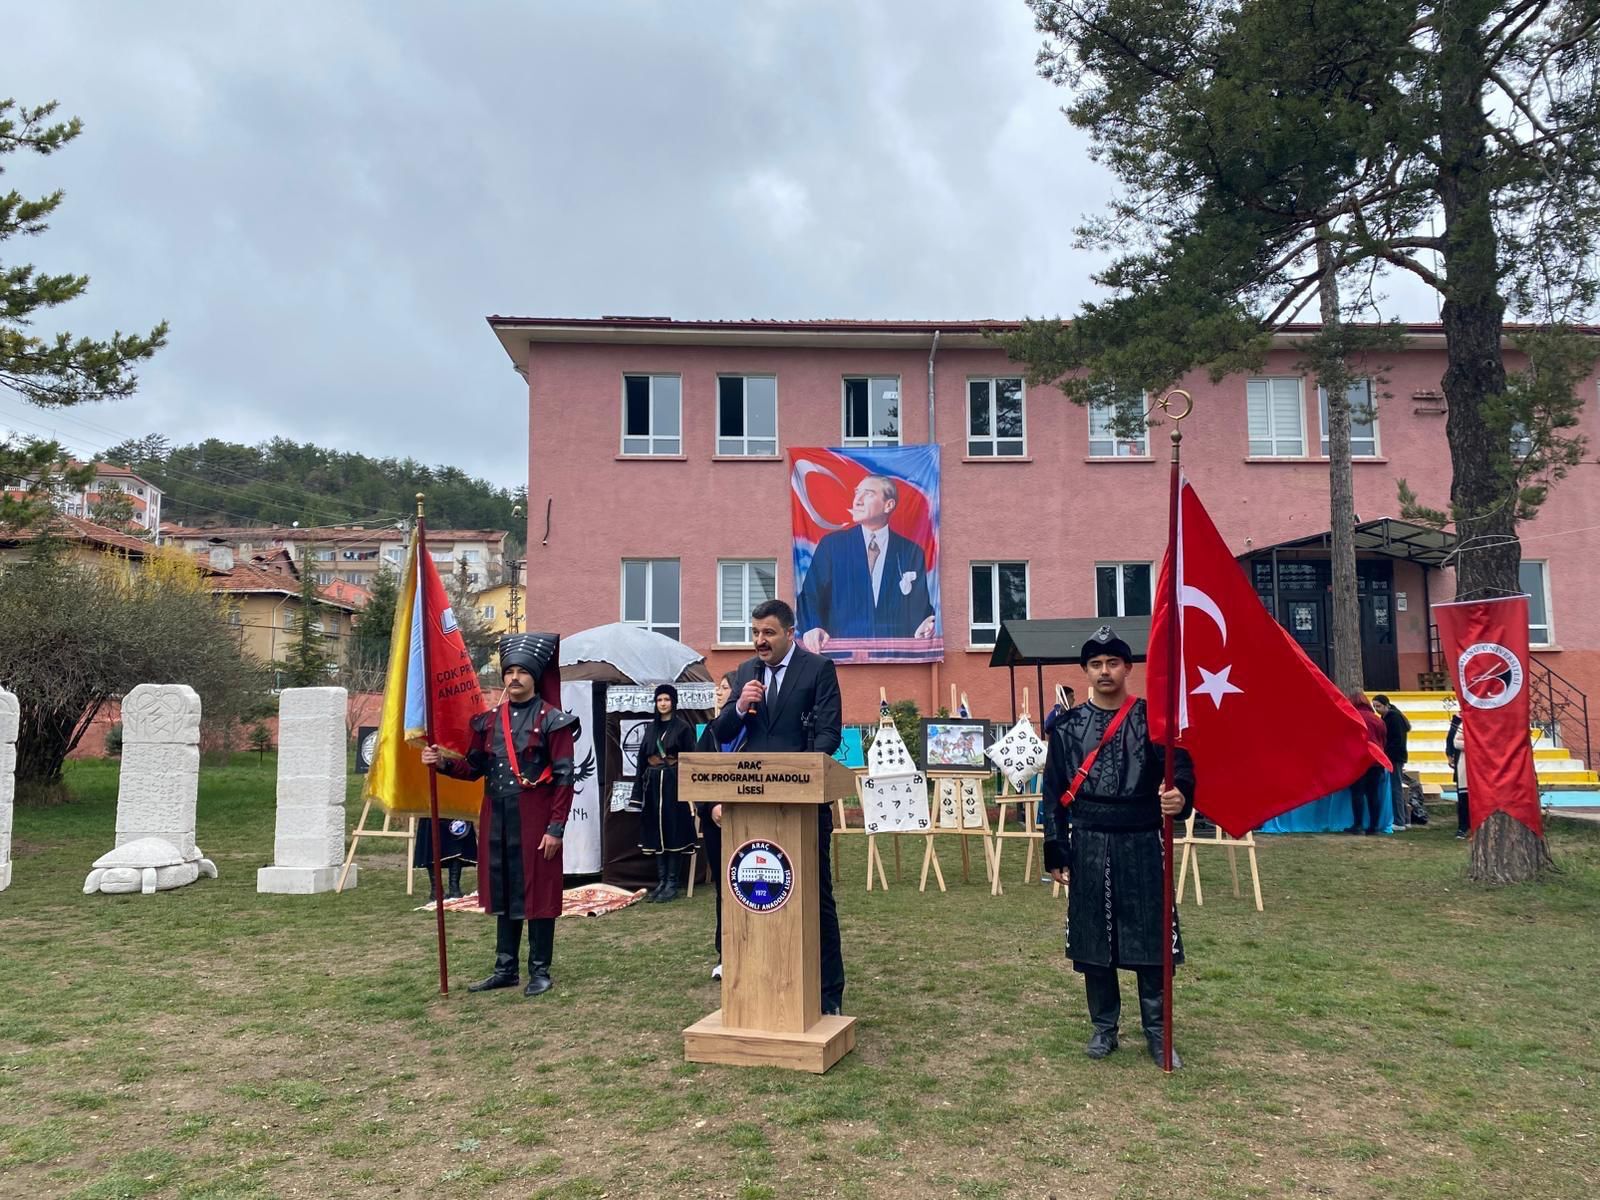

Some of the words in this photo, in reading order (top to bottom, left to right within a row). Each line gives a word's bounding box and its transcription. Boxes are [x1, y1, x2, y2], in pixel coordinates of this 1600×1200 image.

[436, 668, 458, 684] ÇOK
[459, 664, 472, 676] PR
[438, 679, 479, 700] ANADOL
[737, 761, 762, 771] ARAÇ
[691, 773, 710, 783] ÇOK
[711, 773, 763, 783] PROGRAMLI
[765, 774, 810, 784] ANADOLU
[737, 784, 764, 795] LİSESİ
[751, 843, 770, 851] ARAÇ
[732, 882, 760, 910] PROGRAMLI
[761, 892, 787, 911] ANADOLU
[784, 869, 792, 890] LİSESİ
